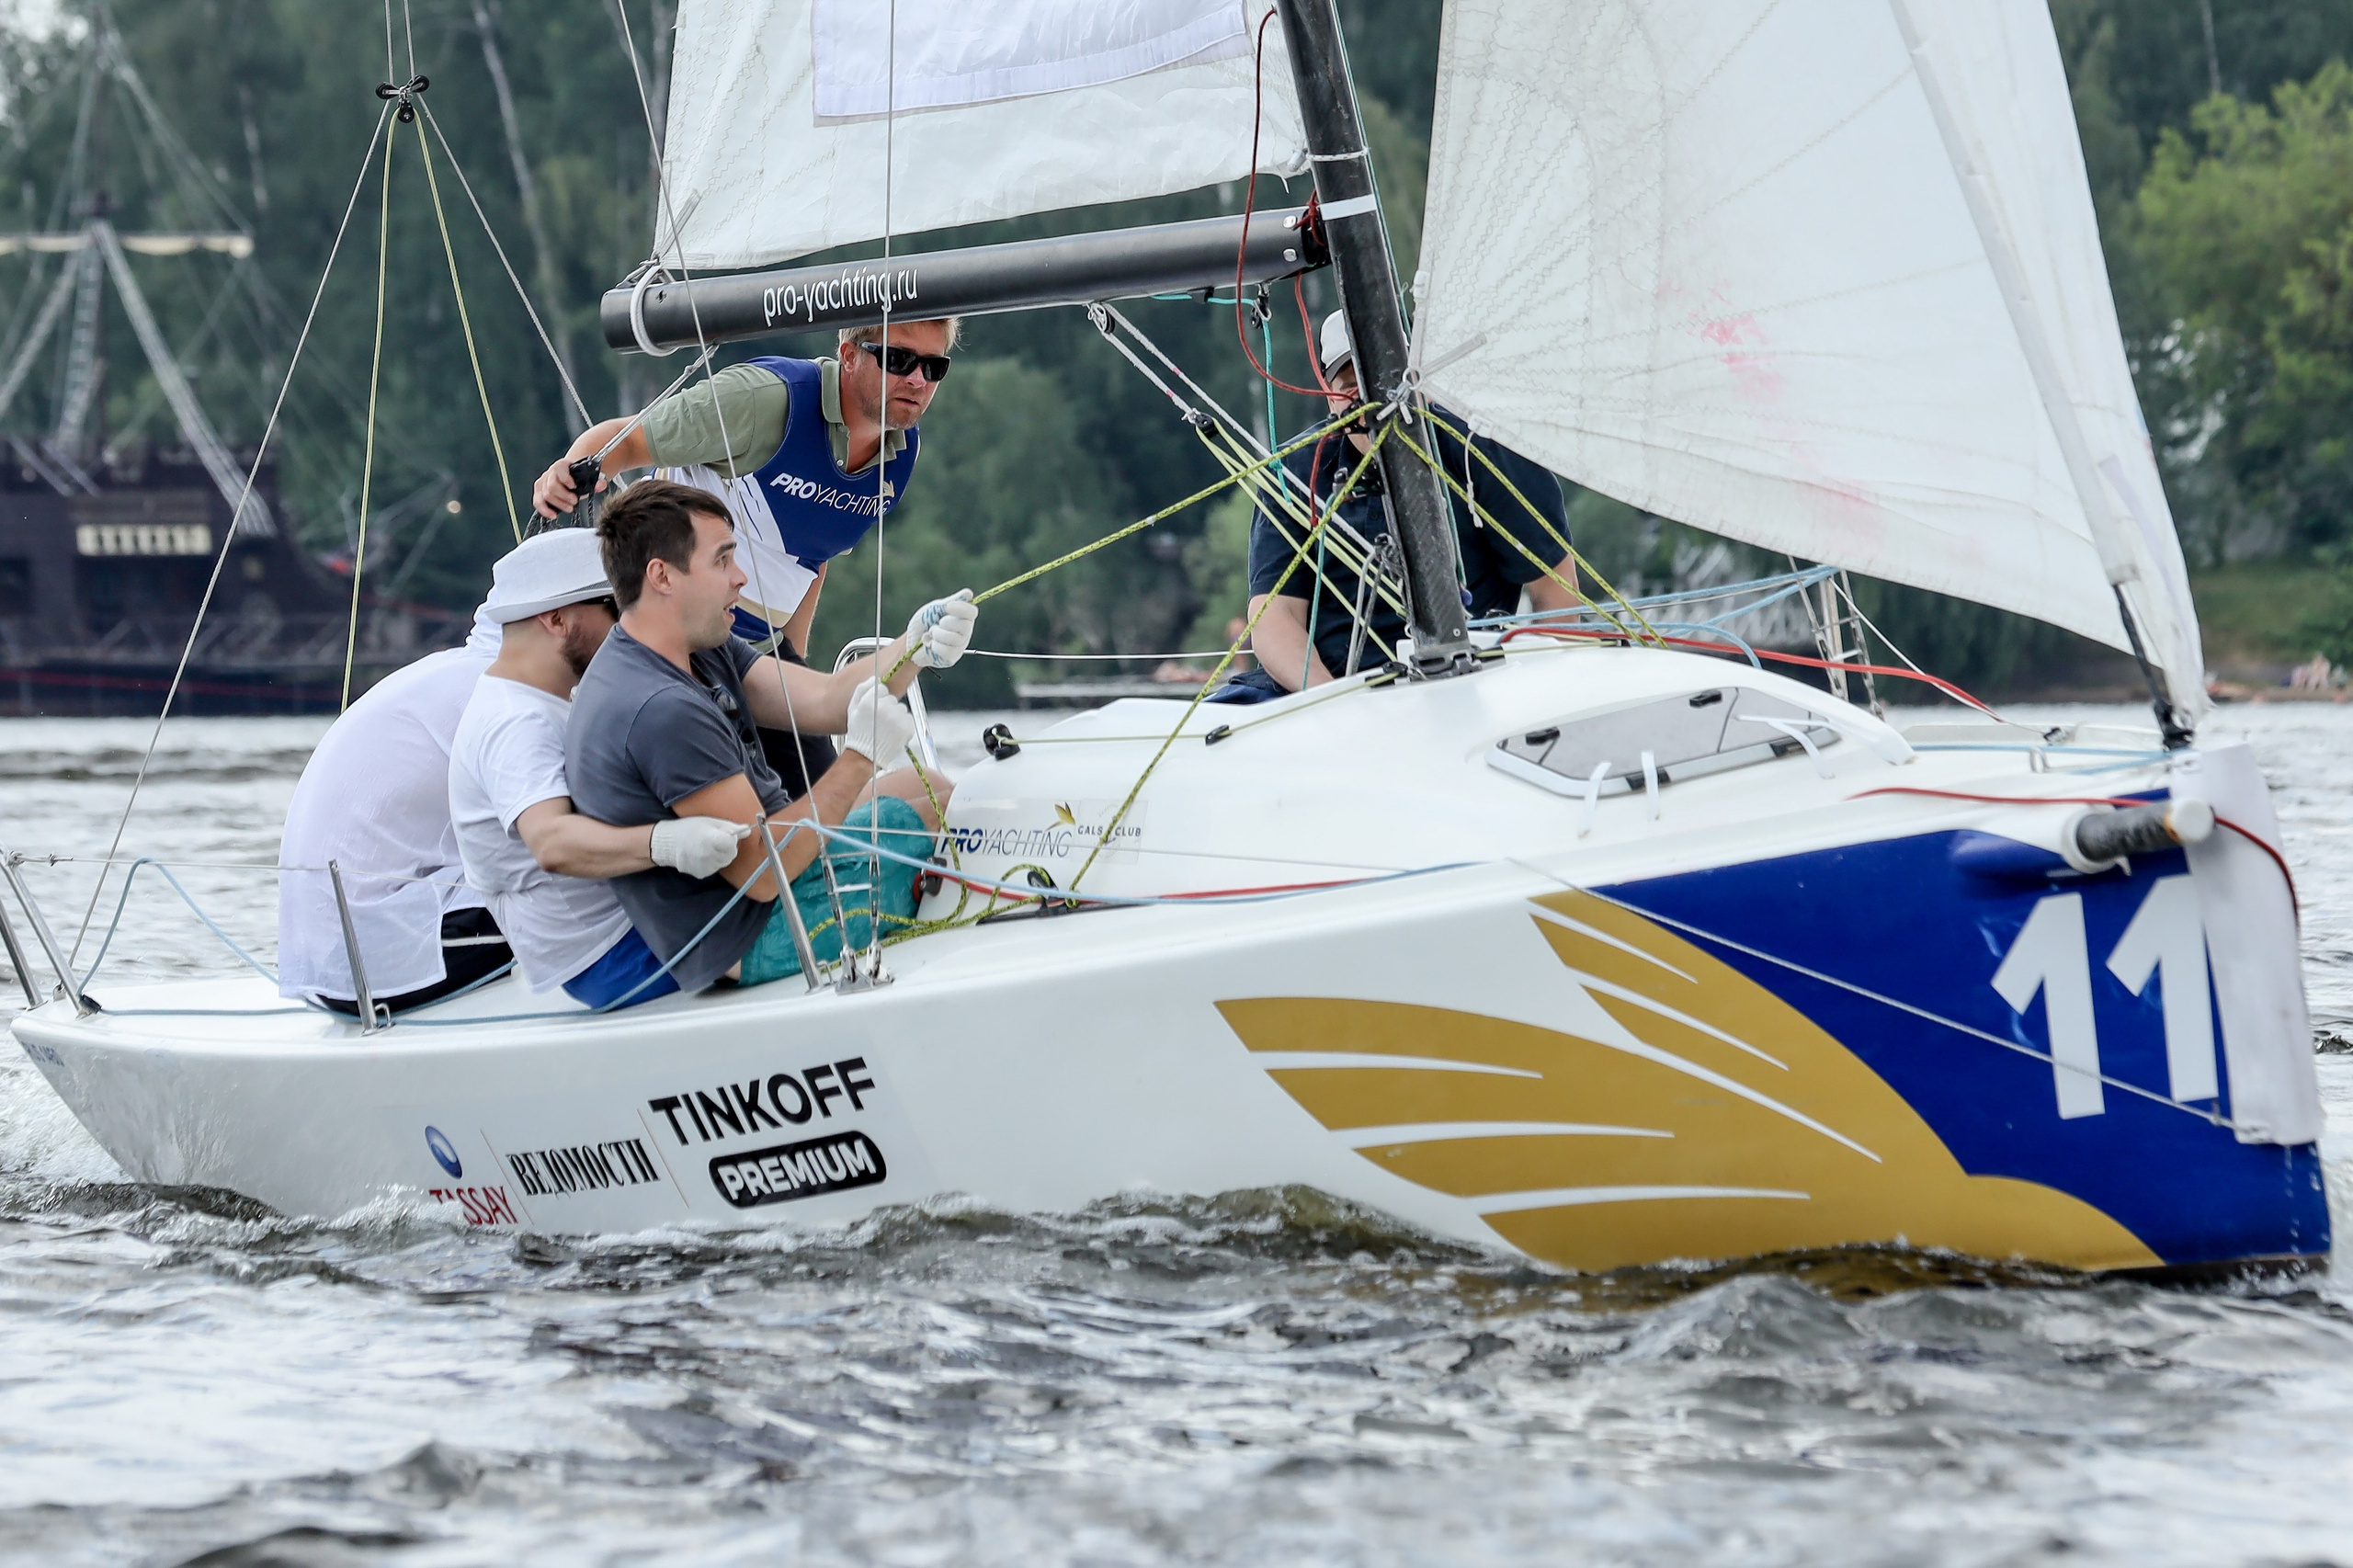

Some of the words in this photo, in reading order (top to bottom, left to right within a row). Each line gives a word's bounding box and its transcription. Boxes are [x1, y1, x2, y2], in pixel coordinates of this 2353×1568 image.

[763, 267, 918, 327] pro-yachting.ru
[769, 472, 892, 518] PROYACHTING
[1077, 824, 1103, 836] GALS
[1114, 826, 1142, 837] CLUB
[1990, 874, 2220, 1120] 11
[647, 1057, 876, 1146] TINKOFF
[505, 1139, 661, 1200] ВЕДОМОСТИ
[717, 1139, 876, 1201] PREMIUM
